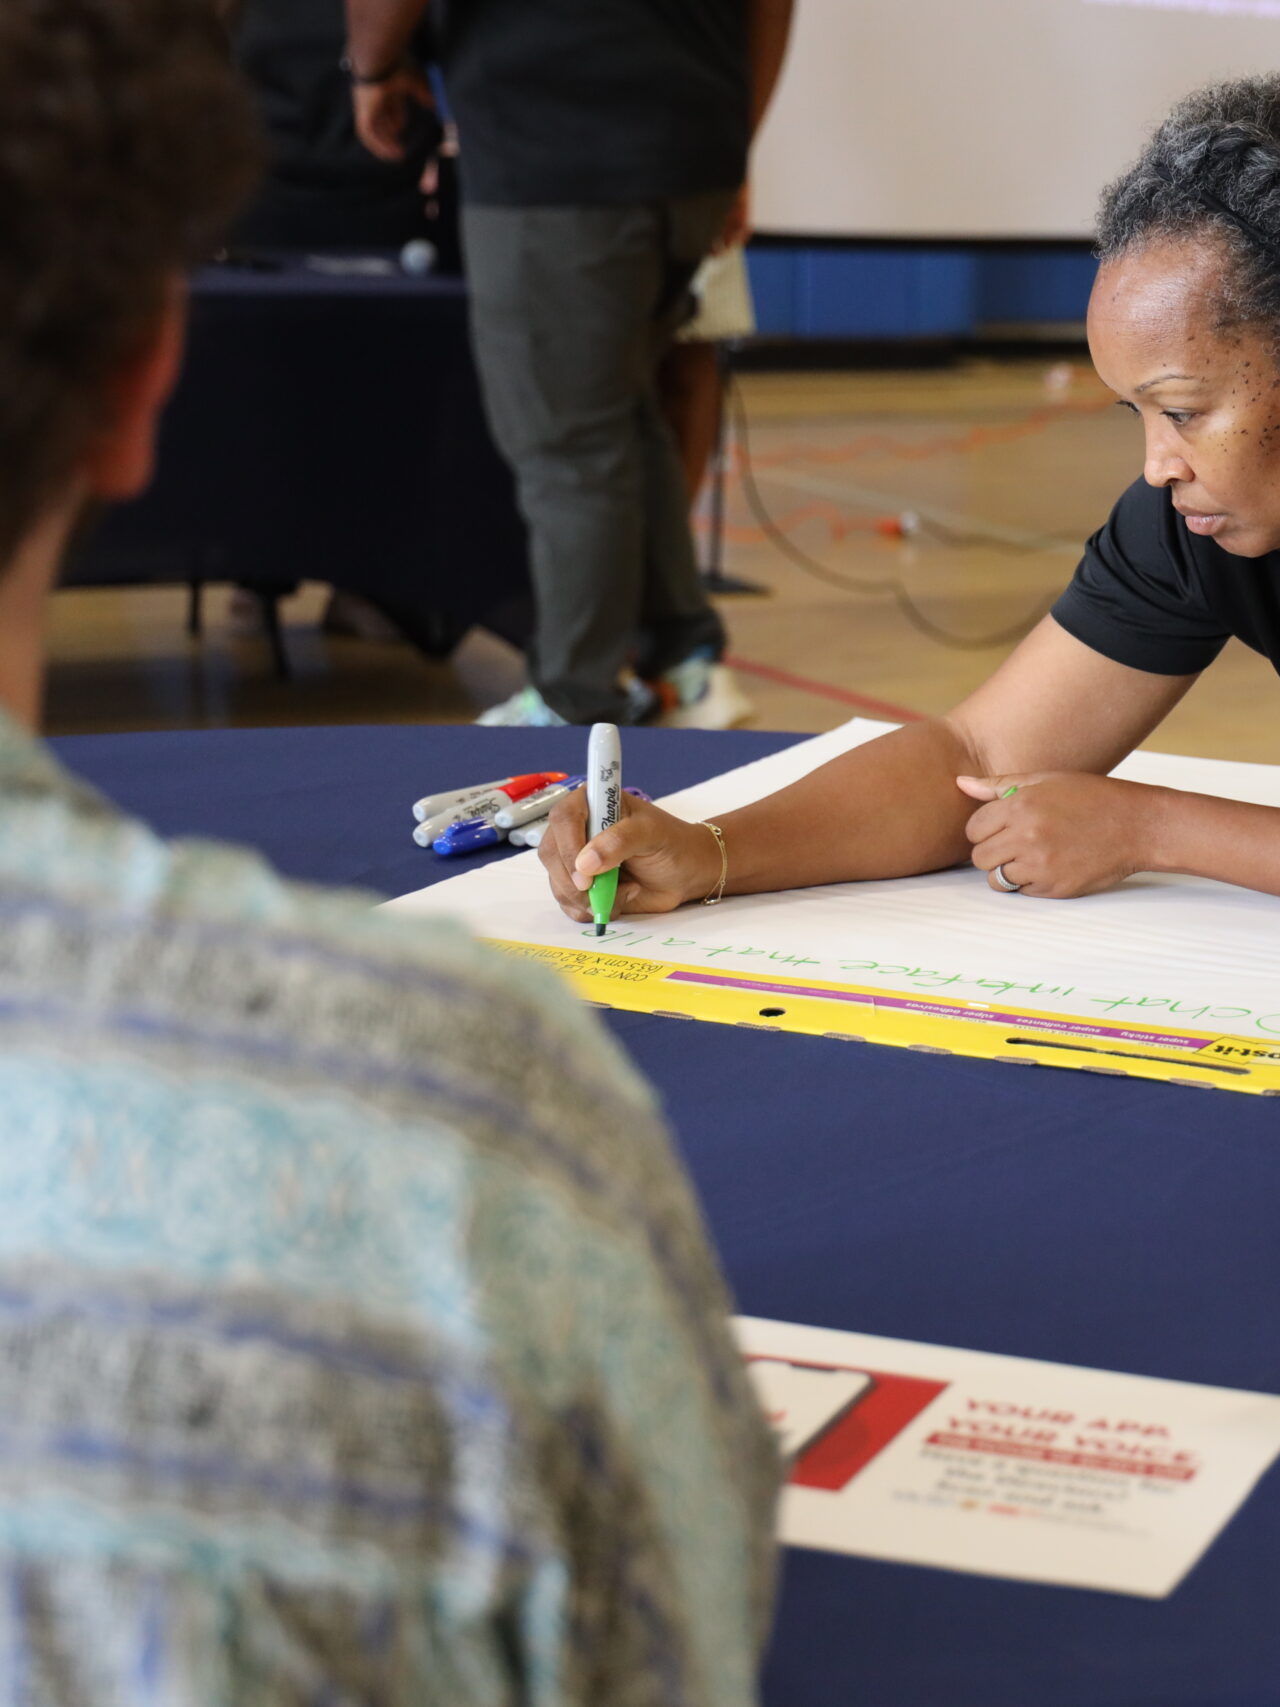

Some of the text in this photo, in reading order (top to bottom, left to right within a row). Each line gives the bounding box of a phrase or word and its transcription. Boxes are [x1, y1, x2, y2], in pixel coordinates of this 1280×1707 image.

[601, 784, 619, 832] Sharpie
[702, 945, 820, 967] that
[606, 969, 648, 982] CONT.
[839, 958, 1075, 999] interface
[1090, 996, 1252, 1020] chat
[1120, 1031, 1190, 1046] super sticky
[966, 1398, 1076, 1425] YOUR
[949, 1416, 1060, 1443] YOUR
